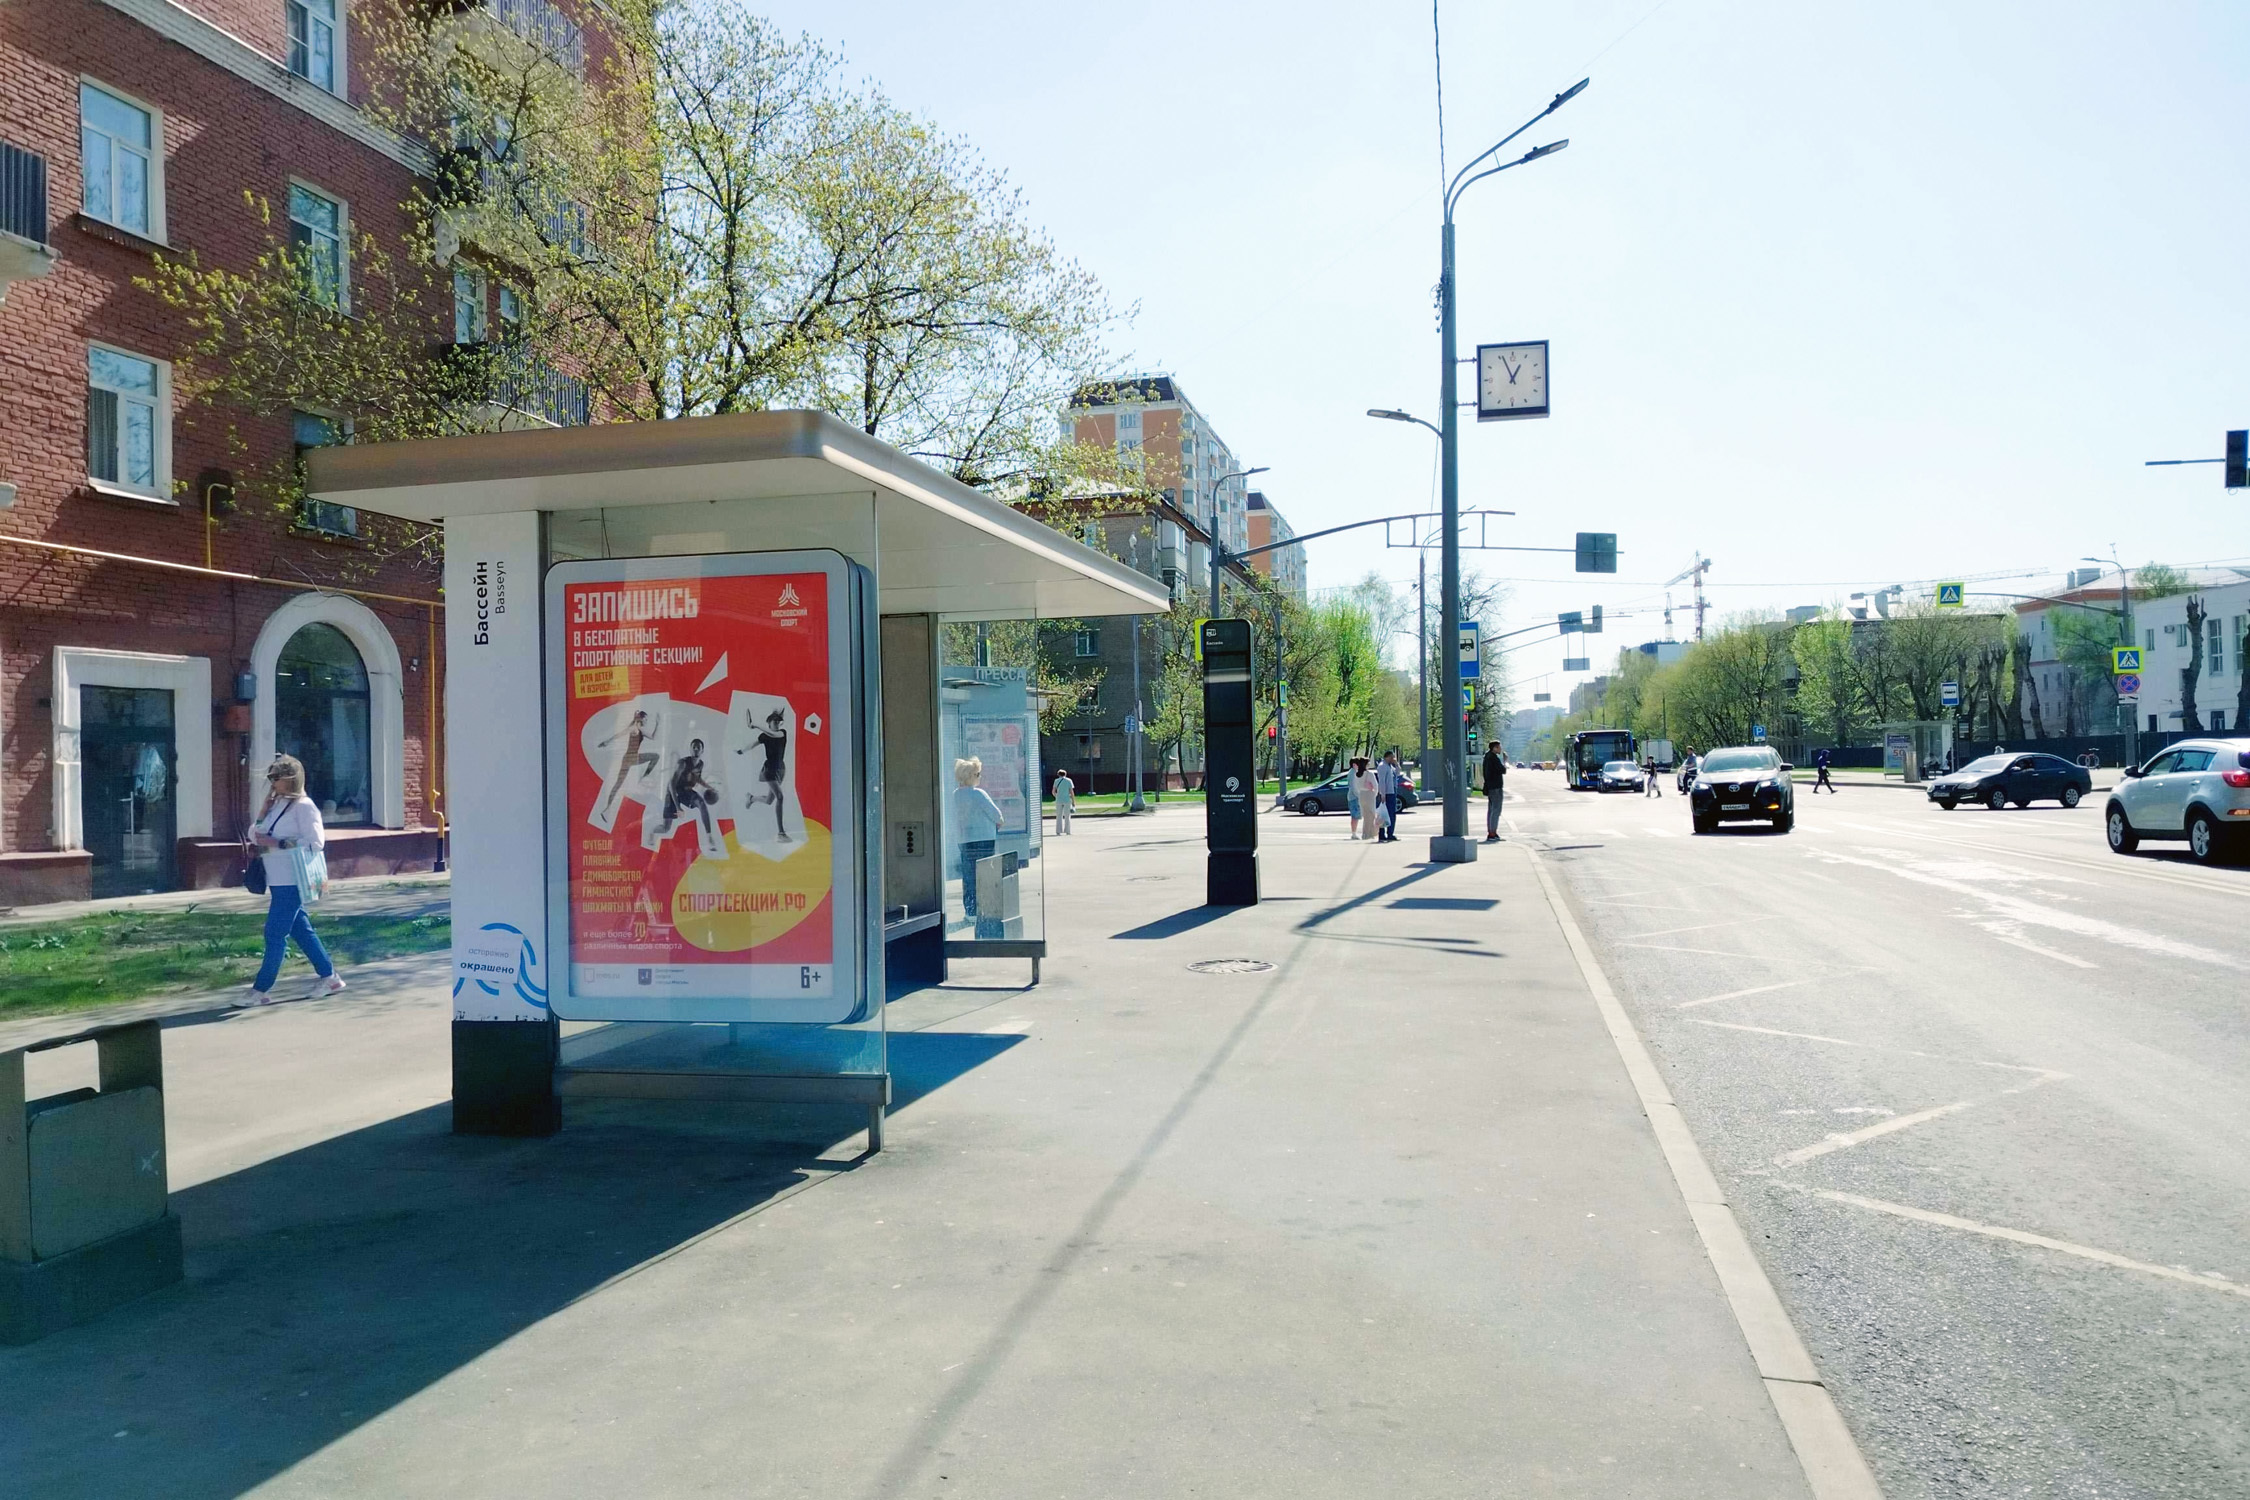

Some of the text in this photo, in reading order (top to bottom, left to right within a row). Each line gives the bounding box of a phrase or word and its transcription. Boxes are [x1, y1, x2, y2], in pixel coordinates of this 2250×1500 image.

[494, 561, 507, 614] Basseyn
[473, 561, 489, 646] Бассейн
[573, 587, 699, 624] ЗАПИШИСЬ
[573, 627, 660, 647] В БЕСПЛАТНЫЕ
[573, 646, 704, 668] СПОРТИВНЫЕ СЕКЦИИ!
[976, 668, 1024, 680] ПРЕССА
[678, 892, 807, 914] СПОРТСЕКЦИИ.РФ
[468, 947, 510, 959] осторожно
[460, 961, 515, 975] окрашено
[801, 966, 822, 989] 6+
